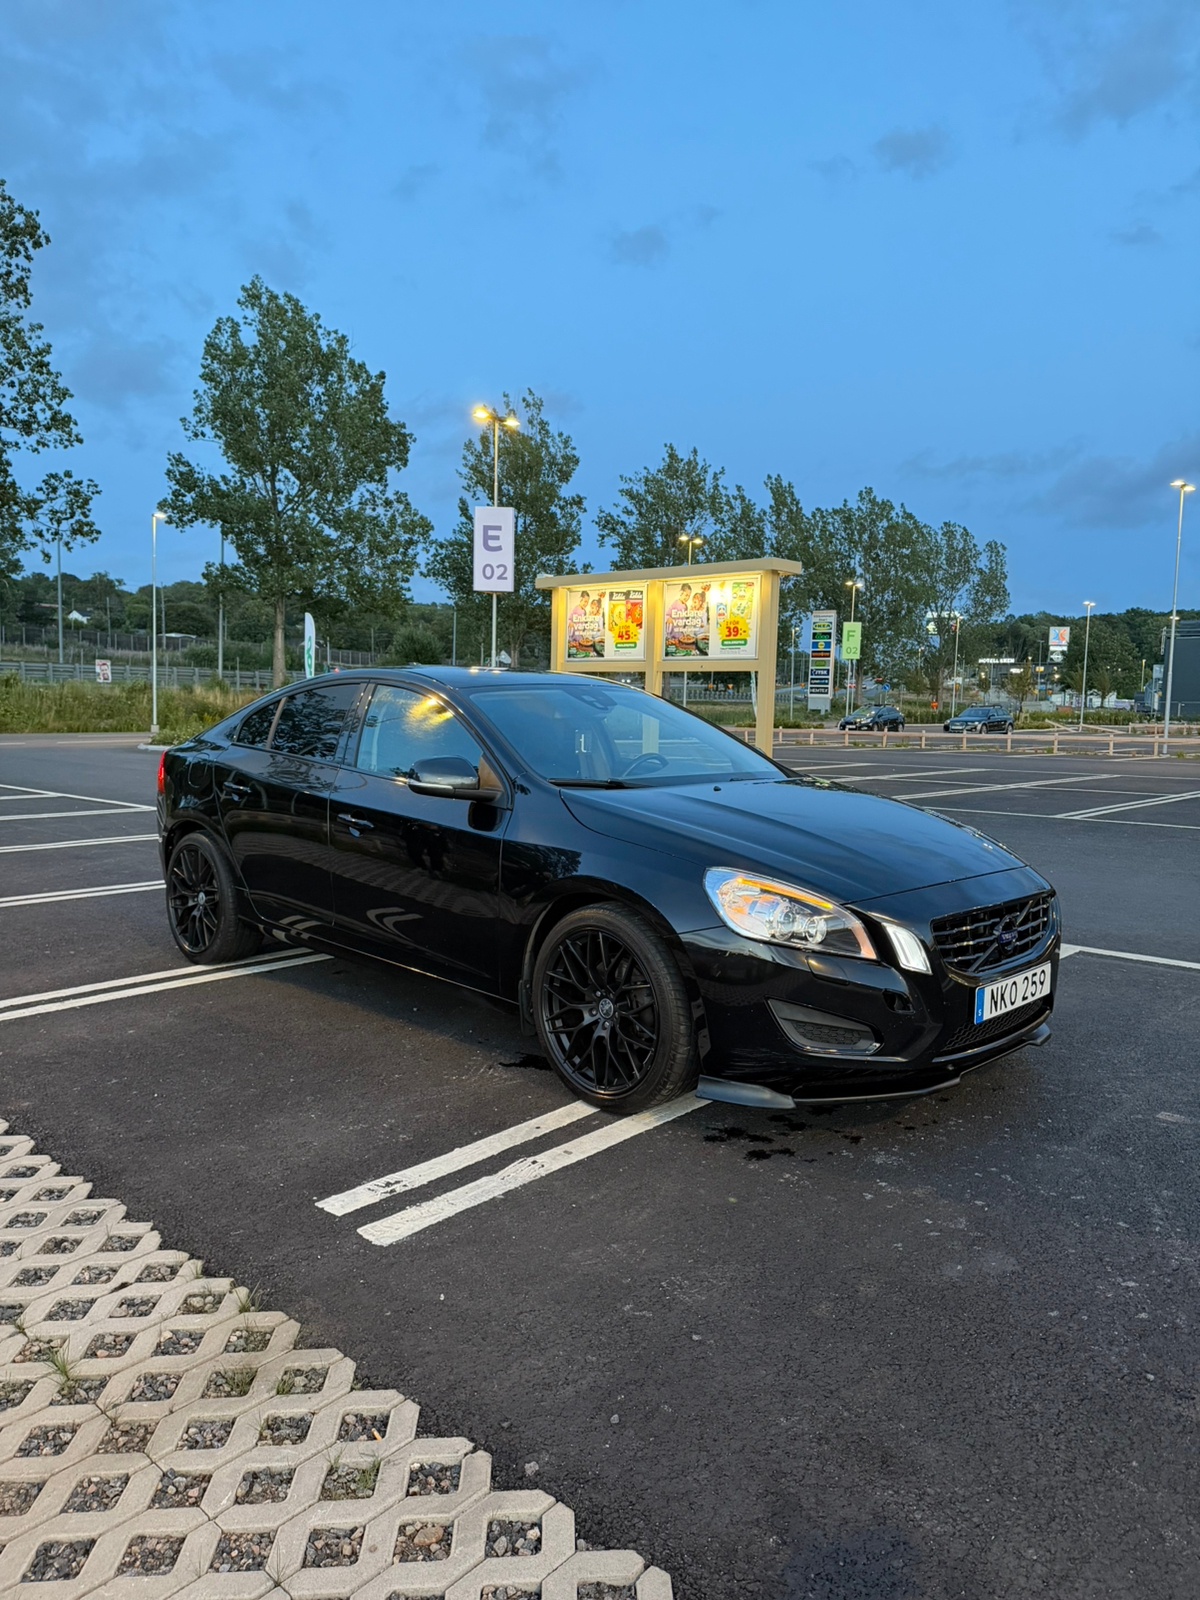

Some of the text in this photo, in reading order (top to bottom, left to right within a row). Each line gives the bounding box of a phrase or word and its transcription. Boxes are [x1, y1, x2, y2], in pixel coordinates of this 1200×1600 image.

[483, 525, 503, 552] E
[482, 563, 508, 580] 02
[672, 608, 703, 618] Enklare
[574, 621, 599, 631] vardag
[673, 617, 702, 627] vardag
[617, 630, 637, 641] 45:-
[725, 626, 747, 638] 39:-
[847, 630, 856, 642] F
[846, 646, 858, 655] 02
[990, 969, 1046, 1014] NKO 259
